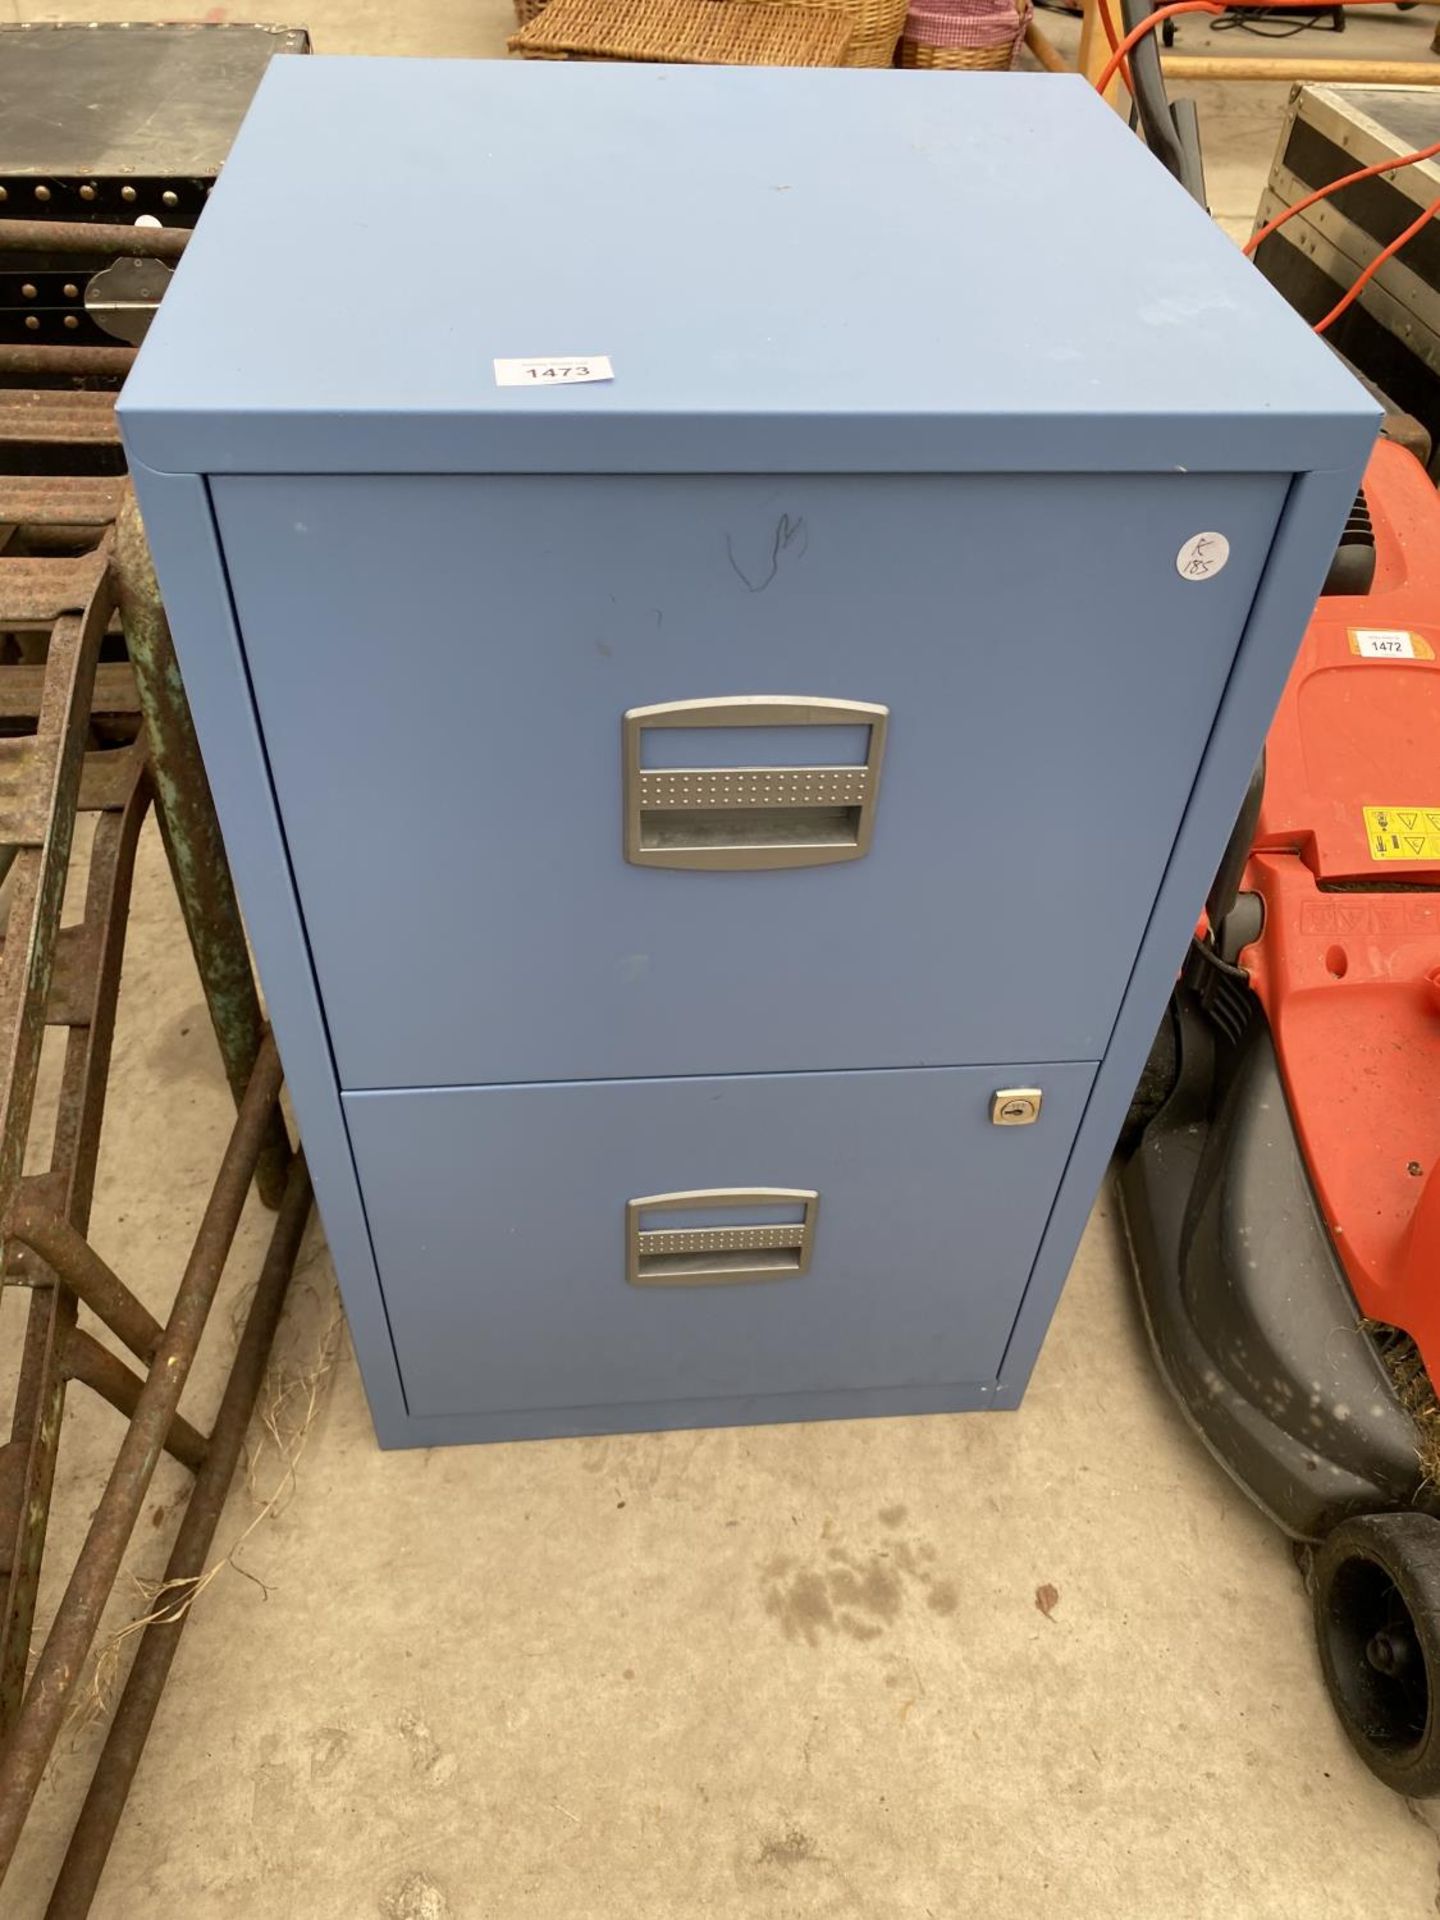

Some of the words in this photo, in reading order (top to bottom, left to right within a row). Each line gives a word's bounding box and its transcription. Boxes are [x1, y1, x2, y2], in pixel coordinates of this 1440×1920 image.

[526, 366, 590, 378] 1473
[1183, 559, 1214, 575] 185
[1371, 641, 1402, 652] 1472
